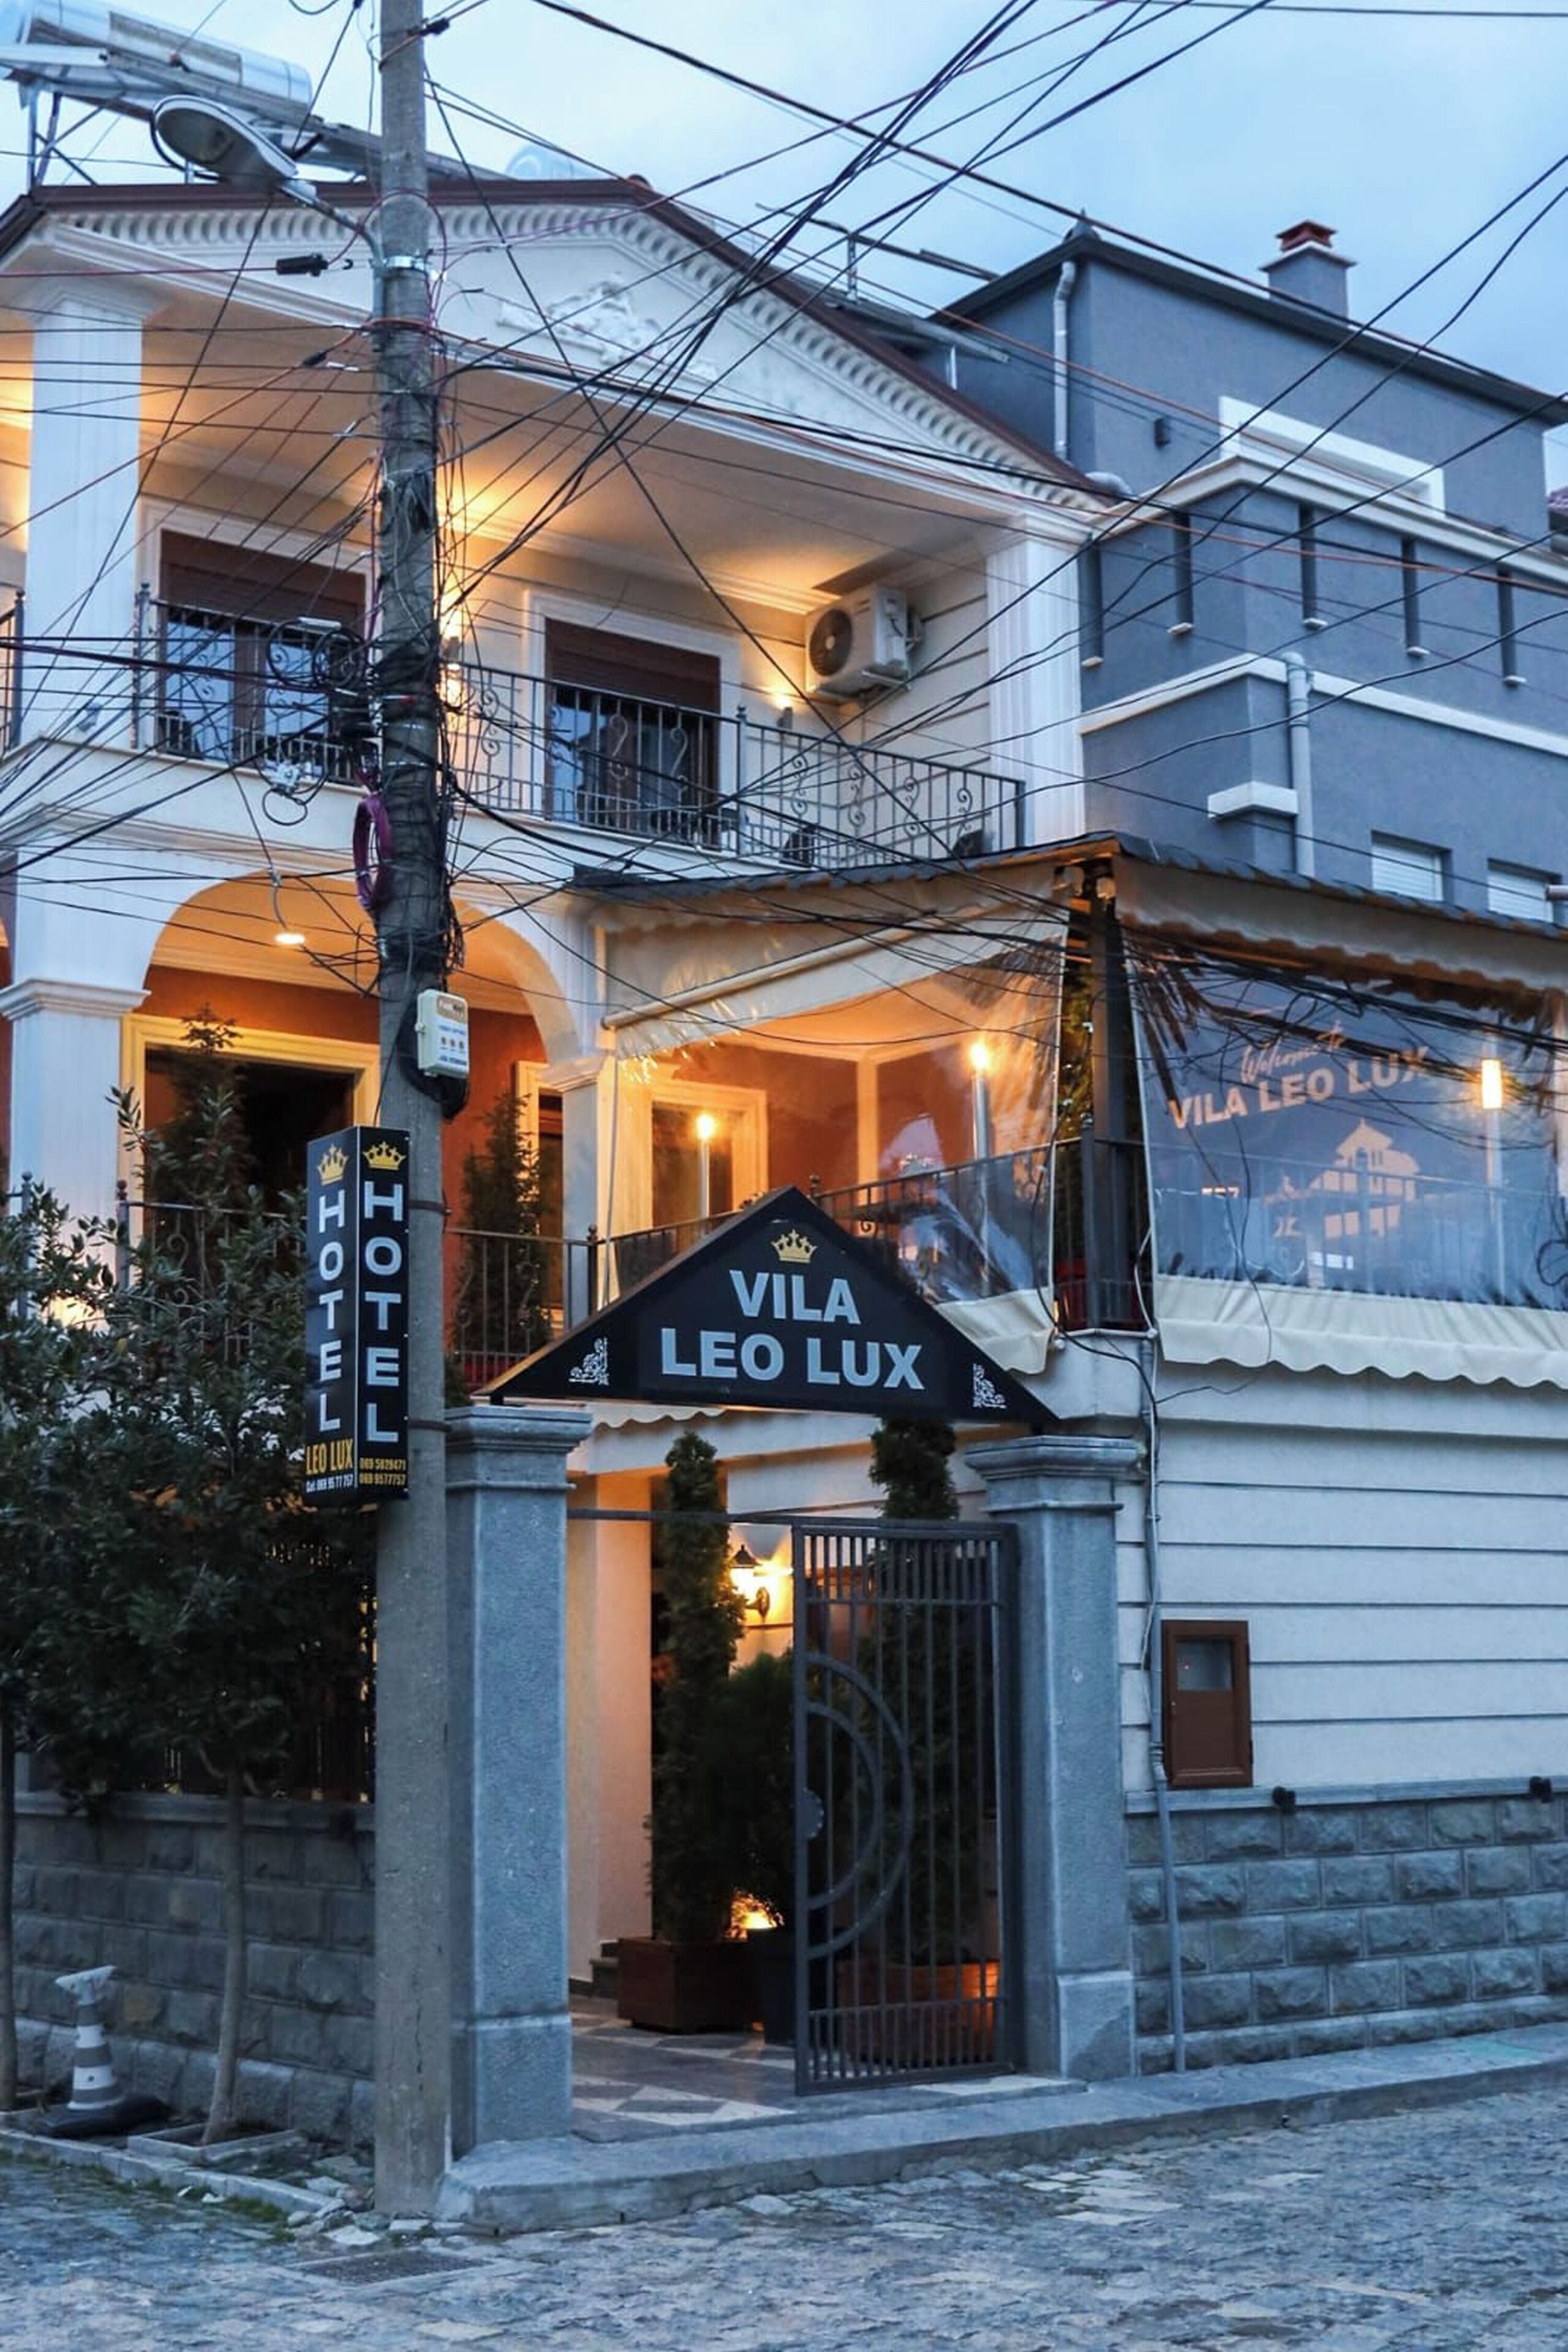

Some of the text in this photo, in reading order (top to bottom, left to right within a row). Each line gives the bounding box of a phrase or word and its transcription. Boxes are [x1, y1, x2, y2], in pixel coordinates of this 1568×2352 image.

[1168, 1087, 1248, 1129] VILA
[1257, 1068, 1334, 1112] LEO
[318, 1189, 345, 1433] HOTEL
[363, 1180, 404, 1442] HOTEL
[729, 1269, 861, 1325] VILA
[660, 1328, 925, 1391] LEO LUX
[306, 1438, 353, 1476] LEO LUX
